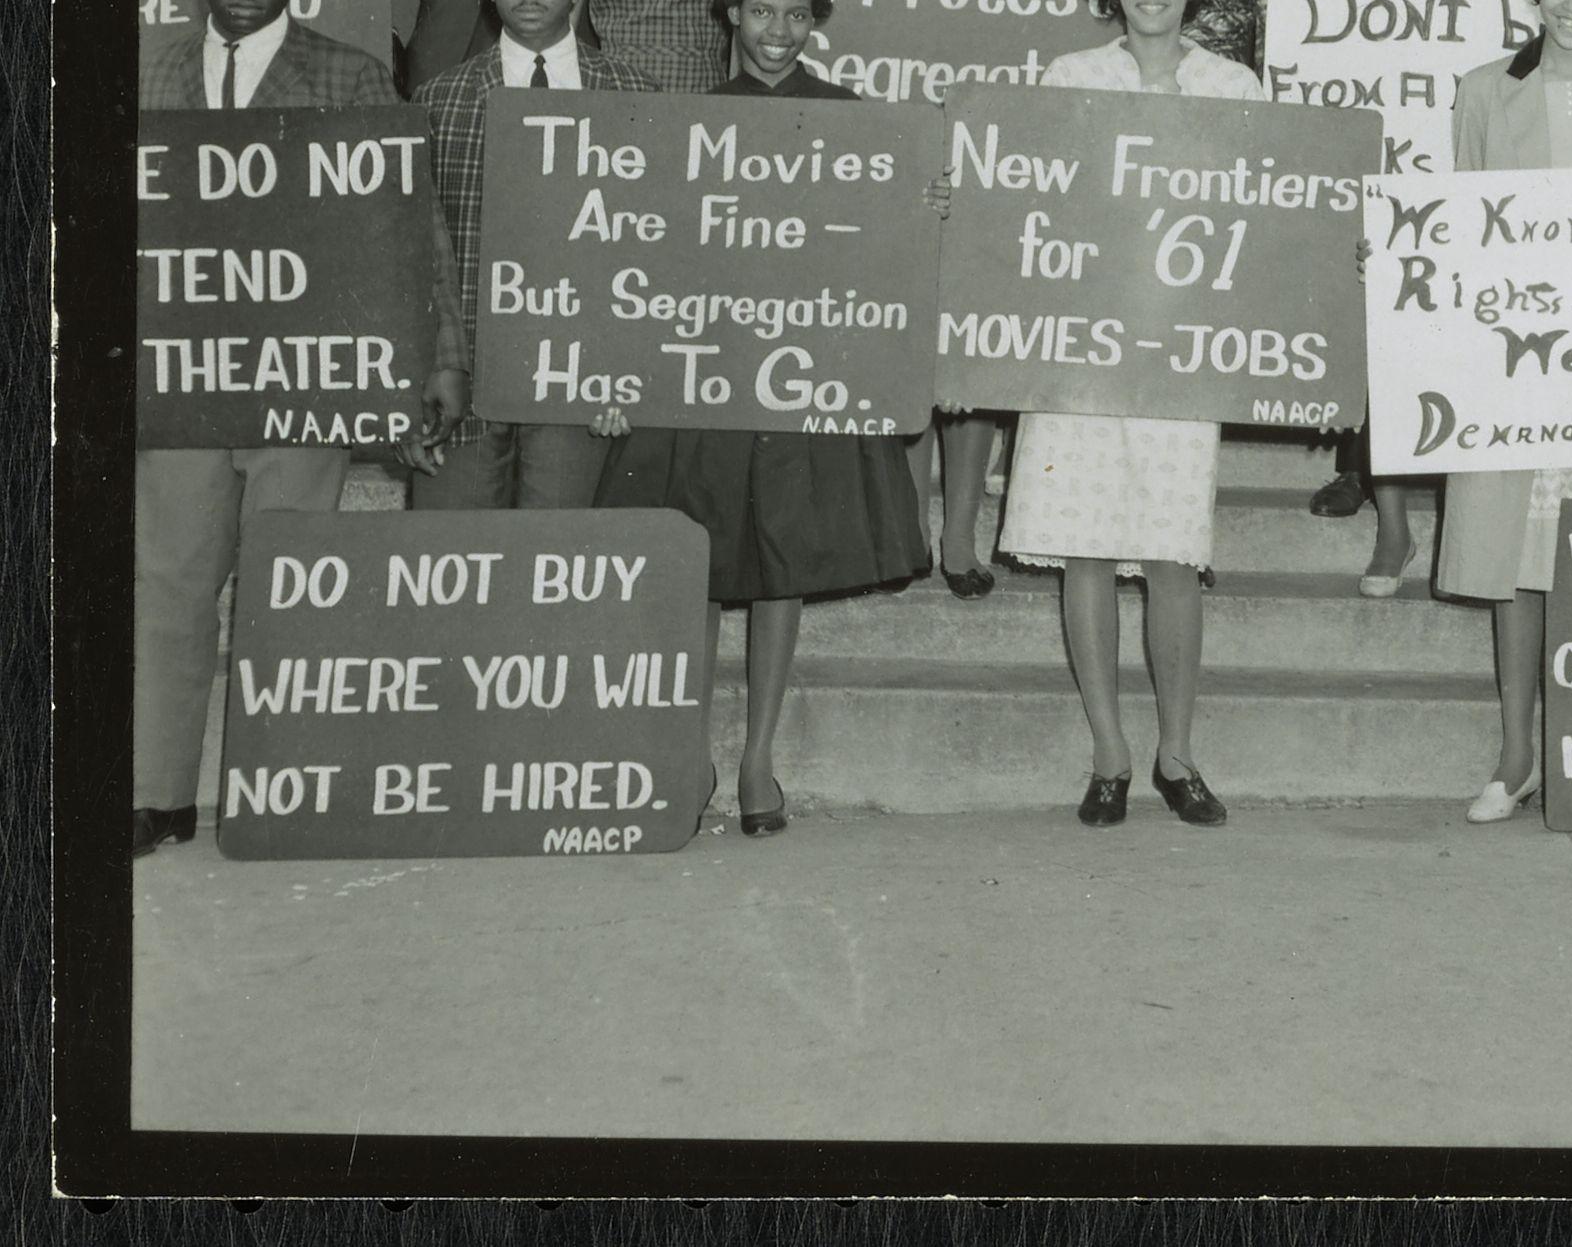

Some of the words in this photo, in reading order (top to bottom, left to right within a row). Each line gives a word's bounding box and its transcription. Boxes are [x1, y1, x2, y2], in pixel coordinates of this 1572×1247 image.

[198, 142, 278, 201] DO
[308, 136, 426, 197] NOT
[522, 115, 647, 180] The
[686, 122, 895, 184] Movies
[950, 120, 1080, 194] New
[1111, 133, 1360, 216] Frontiers
[568, 188, 667, 242] Are
[700, 194, 807, 249] Fine
[1018, 210, 1099, 280] for
[136, 247, 309, 304] TEND
[490, 260, 581, 317] But
[610, 267, 908, 340] Segregation
[142, 335, 411, 394] THEATER.
[532, 338, 643, 405] Has
[660, 343, 731, 405] To
[755, 345, 872, 412] Go.
[1252, 398, 1340, 425] NAACP
[270, 555, 349, 610] DO
[386, 553, 504, 607] NOT
[532, 553, 647, 604] BUY
[238, 656, 442, 716] WHERE
[462, 654, 569, 711] YOU
[593, 652, 699, 709] WILL
[225, 765, 342, 818] NOT
[372, 762, 452, 815] BE
[482, 761, 668, 813] HIRED.
[543, 825, 643, 854] NAACP
